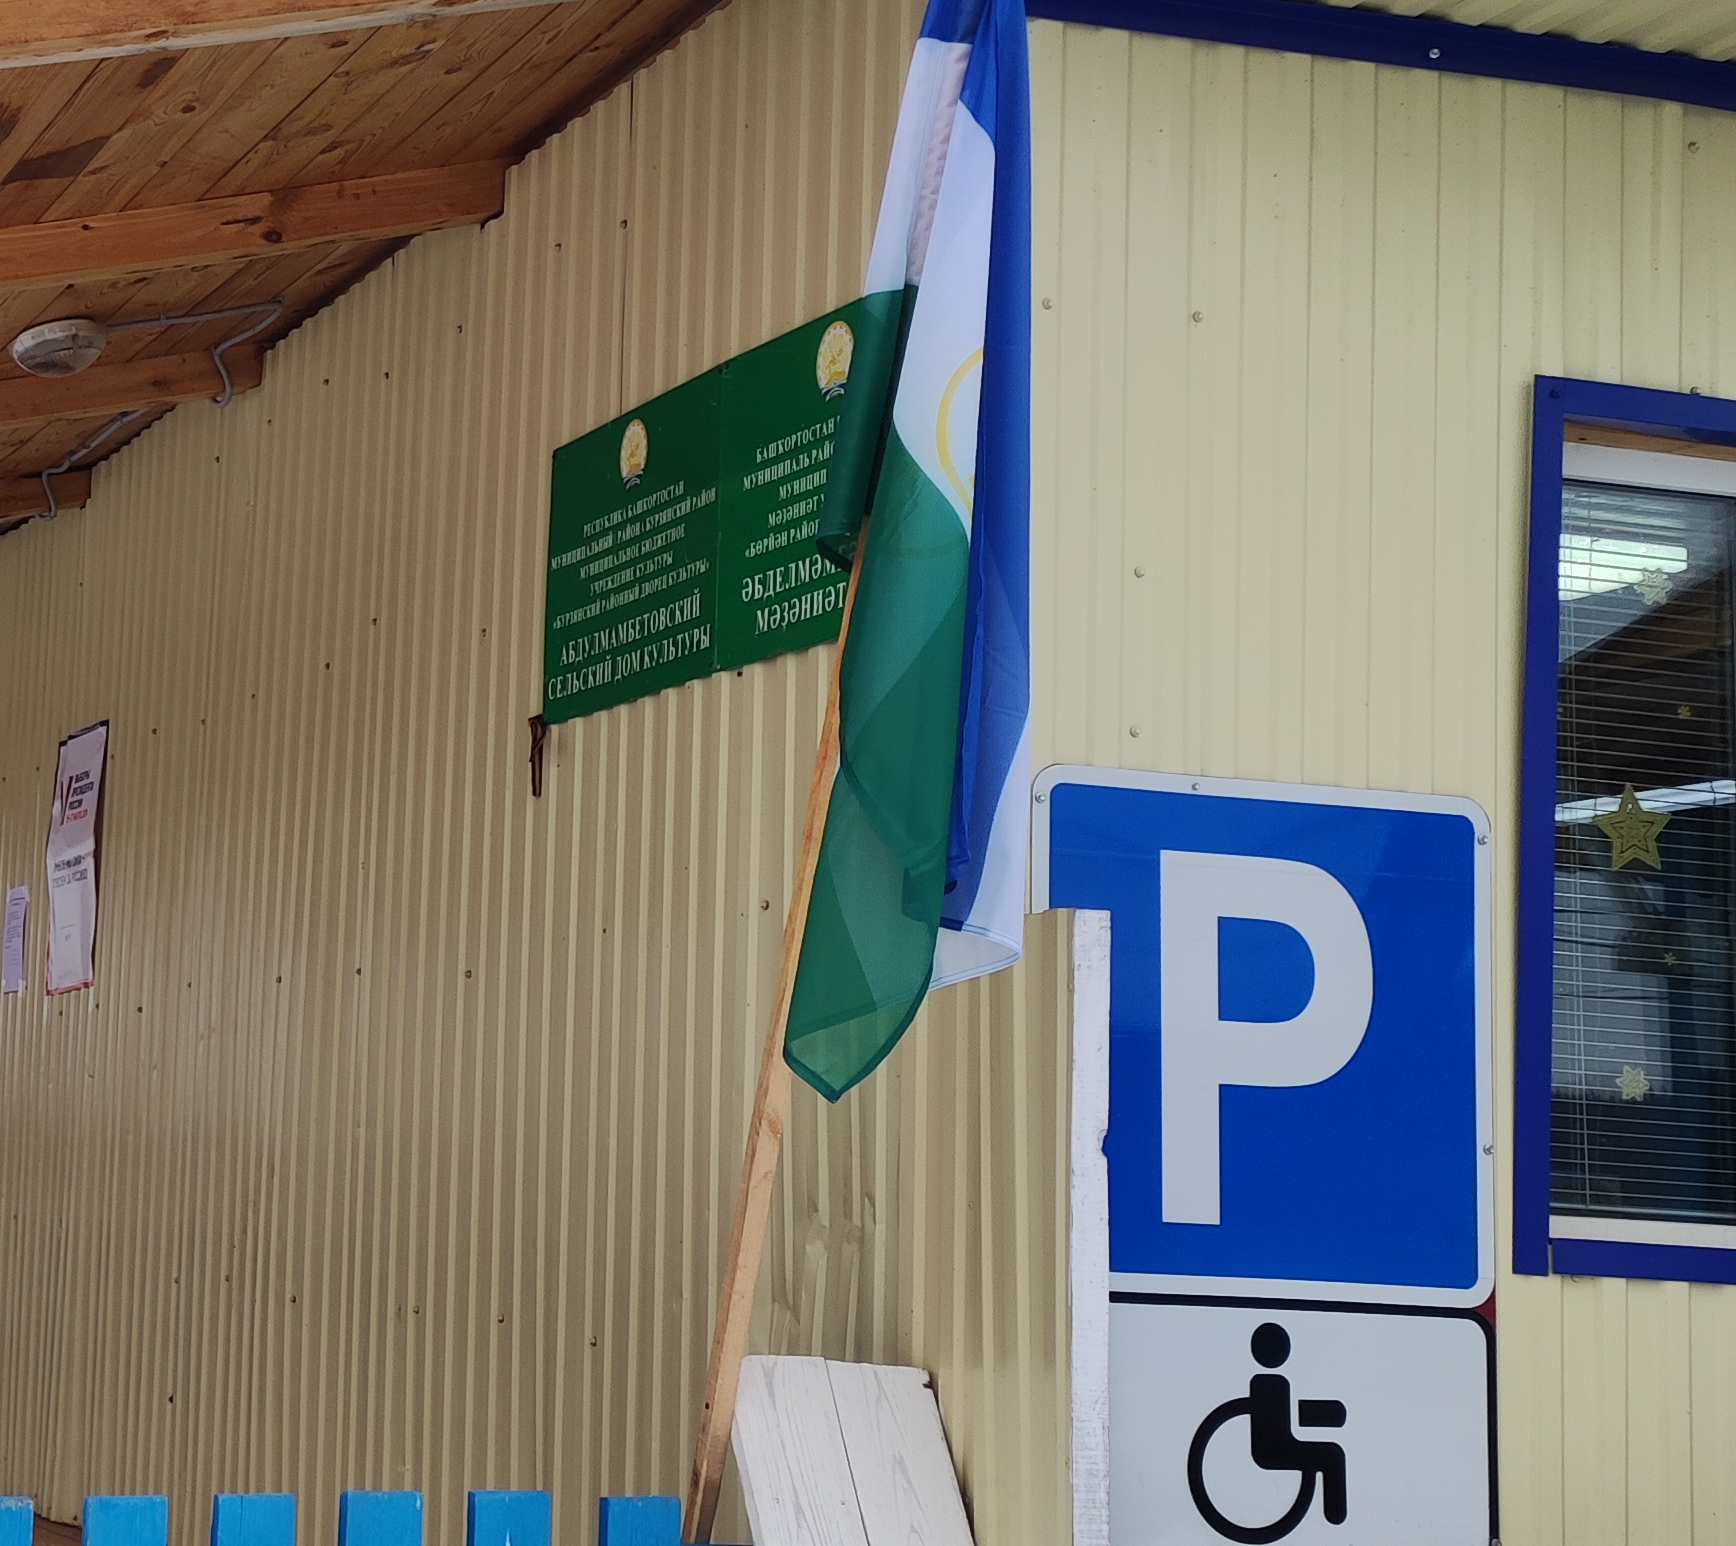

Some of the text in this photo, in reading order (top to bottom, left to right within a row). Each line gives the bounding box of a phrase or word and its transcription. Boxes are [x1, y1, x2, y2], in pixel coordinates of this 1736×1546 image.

[743, 452, 809, 491] МУНИЦИПАЛЬ
[779, 468, 827, 501] МУНИЦИП
[551, 530, 613, 571] МУНИЦИПАЛЬНЫЙ
[645, 496, 692, 532] БУРЗЯНСКИЙ
[692, 486, 717, 512] РАЙОН
[583, 480, 685, 538] РЕСПУБЛИКА БАШКОРТОСТАН
[579, 523, 686, 581] МУНИЦИПАЛЬНОЕ БЮДЖЕТНОЕ
[590, 550, 674, 597] УЧРЕЖДЕНИЕ КУЛЬТУРЫ
[742, 553, 842, 603] ӘБДЕЛМӘМ
[602, 583, 640, 612] РАЙОННЫЙ
[640, 573, 667, 599] ДВОРЕЦ
[559, 587, 702, 667] АБДУЛМАМБЕТОВСКИЙ
[548, 623, 711, 700] СЕЛЬСКИЙ ДОМ КУЛЬТУРЫ
[1160, 849, 1374, 1226] P
